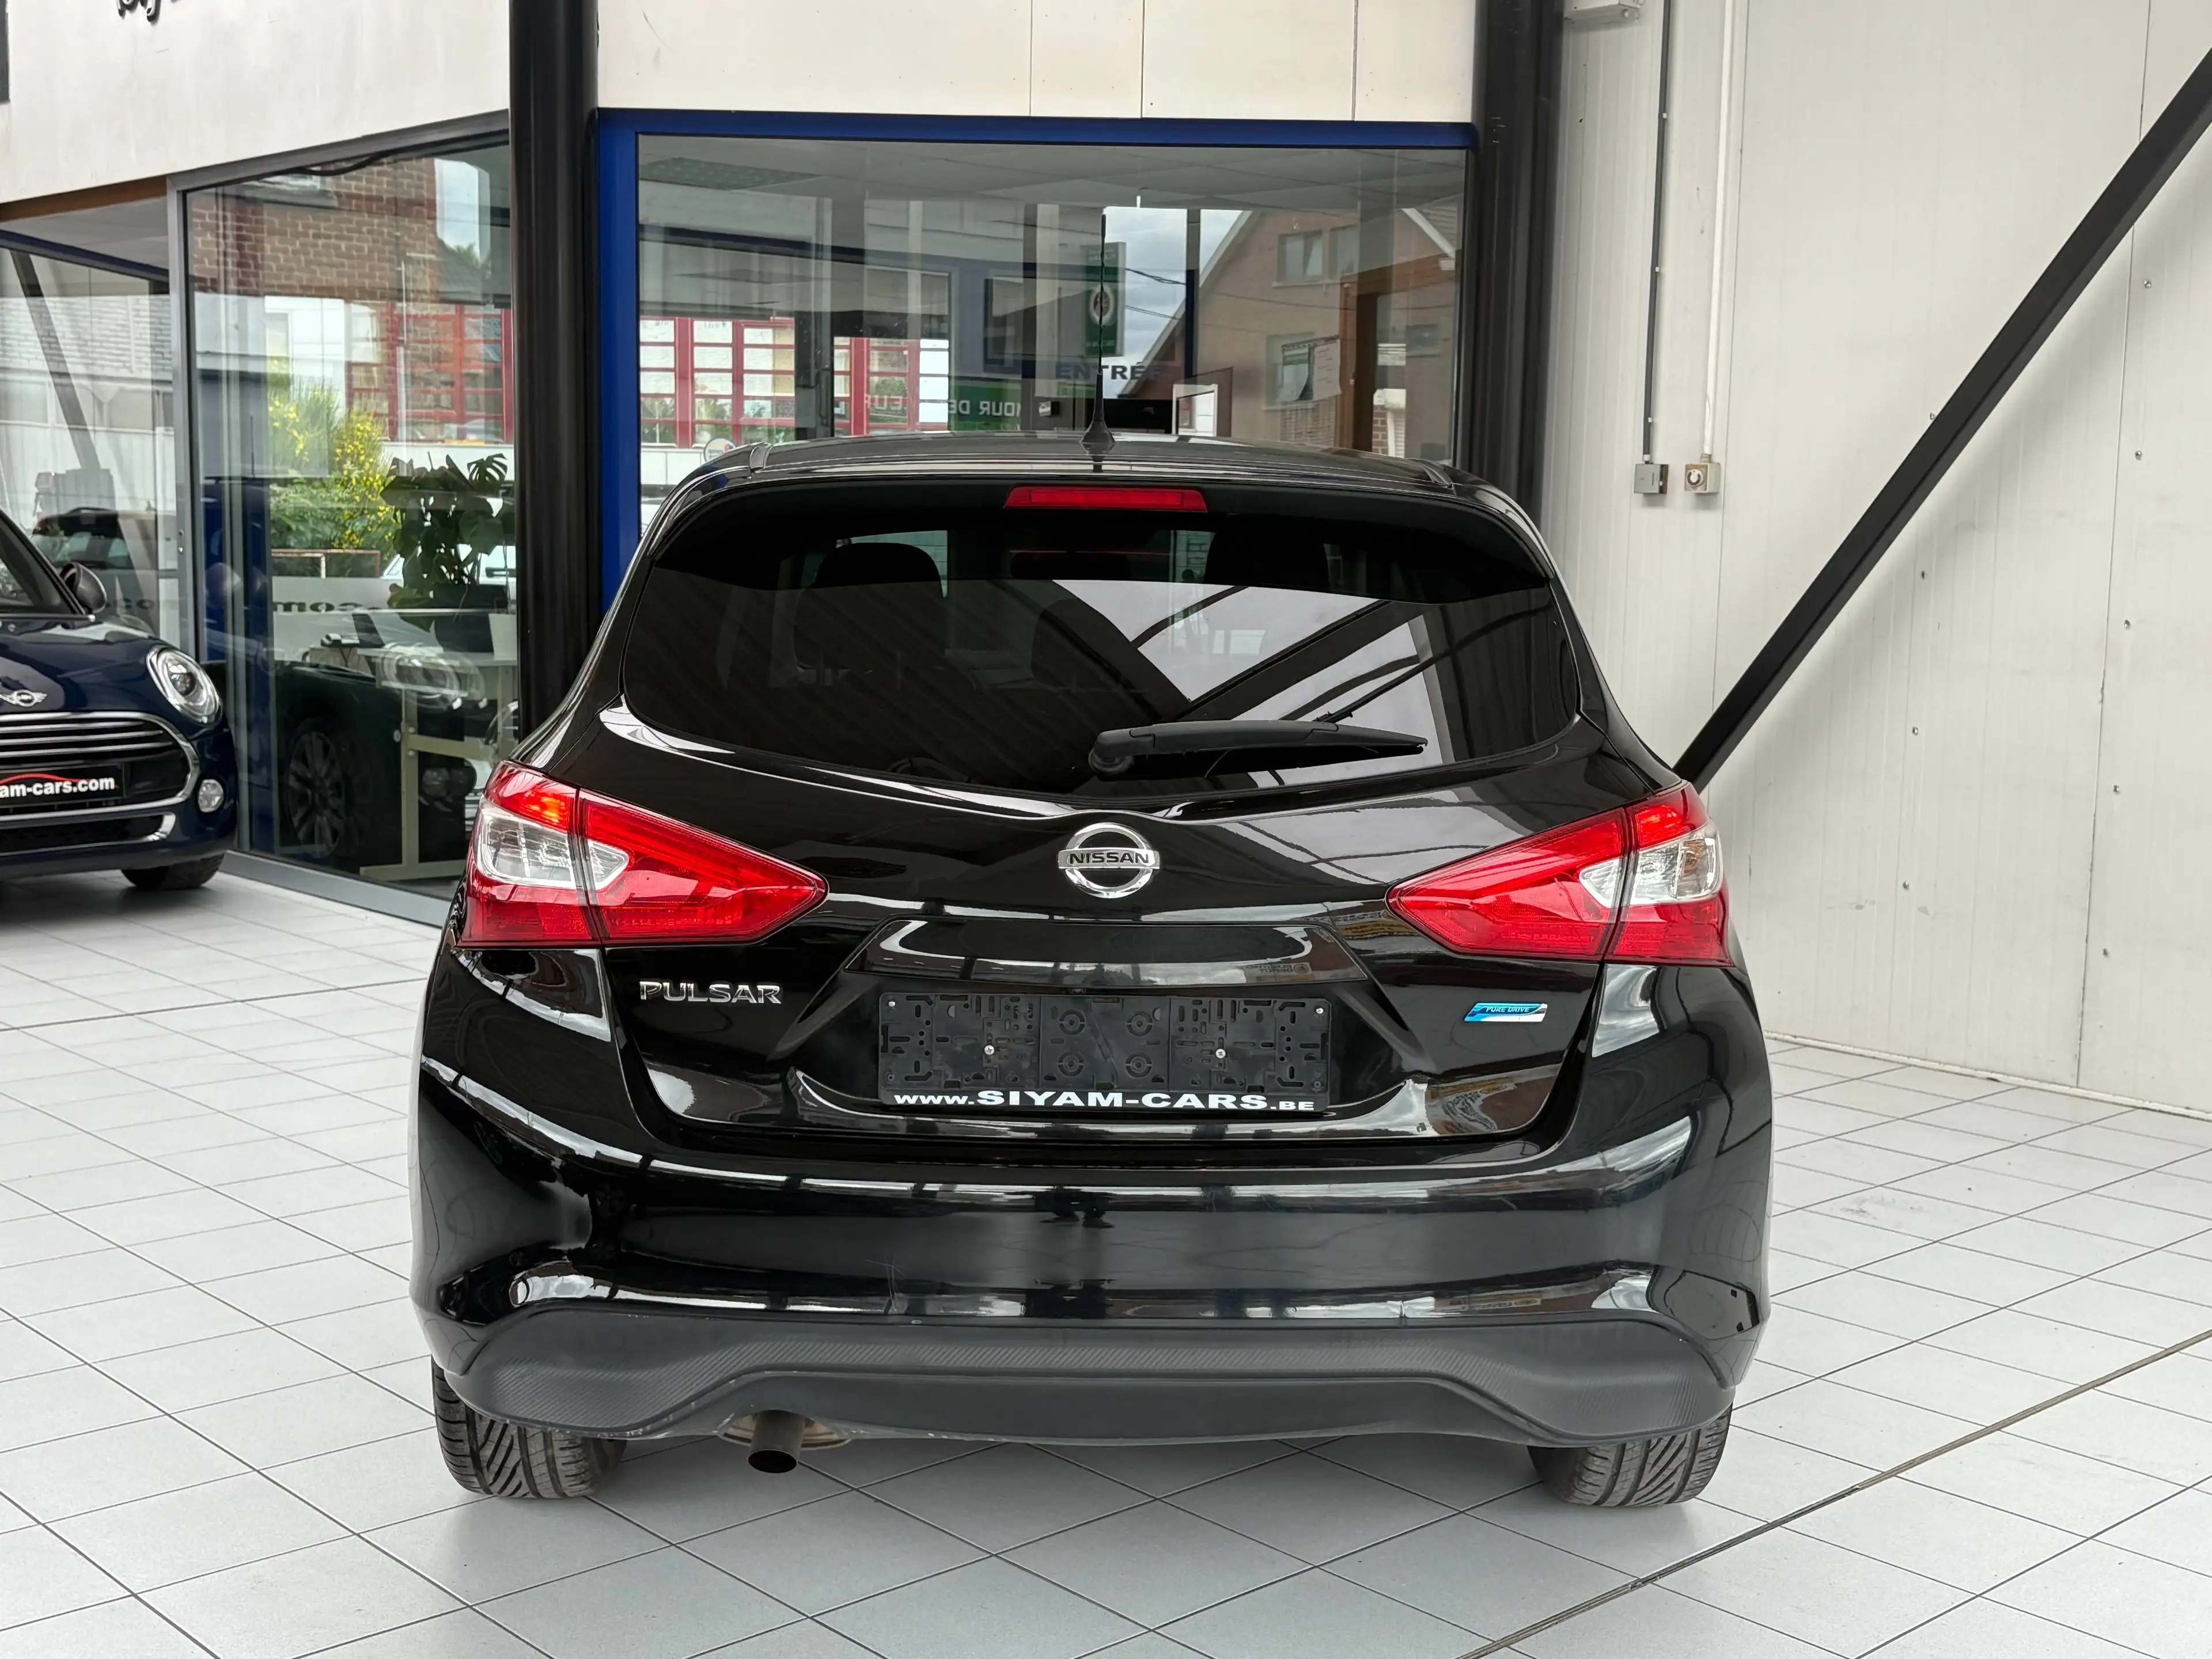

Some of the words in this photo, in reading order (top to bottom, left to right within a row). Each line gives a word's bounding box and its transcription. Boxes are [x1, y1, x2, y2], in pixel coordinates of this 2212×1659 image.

[0, 777, 115, 798] am-cars.com
[1070, 853, 1149, 864] NISSAN
[640, 981, 781, 1003] PULSAR
[894, 1090, 1315, 1111] www.SIYAM-CARS.BE
